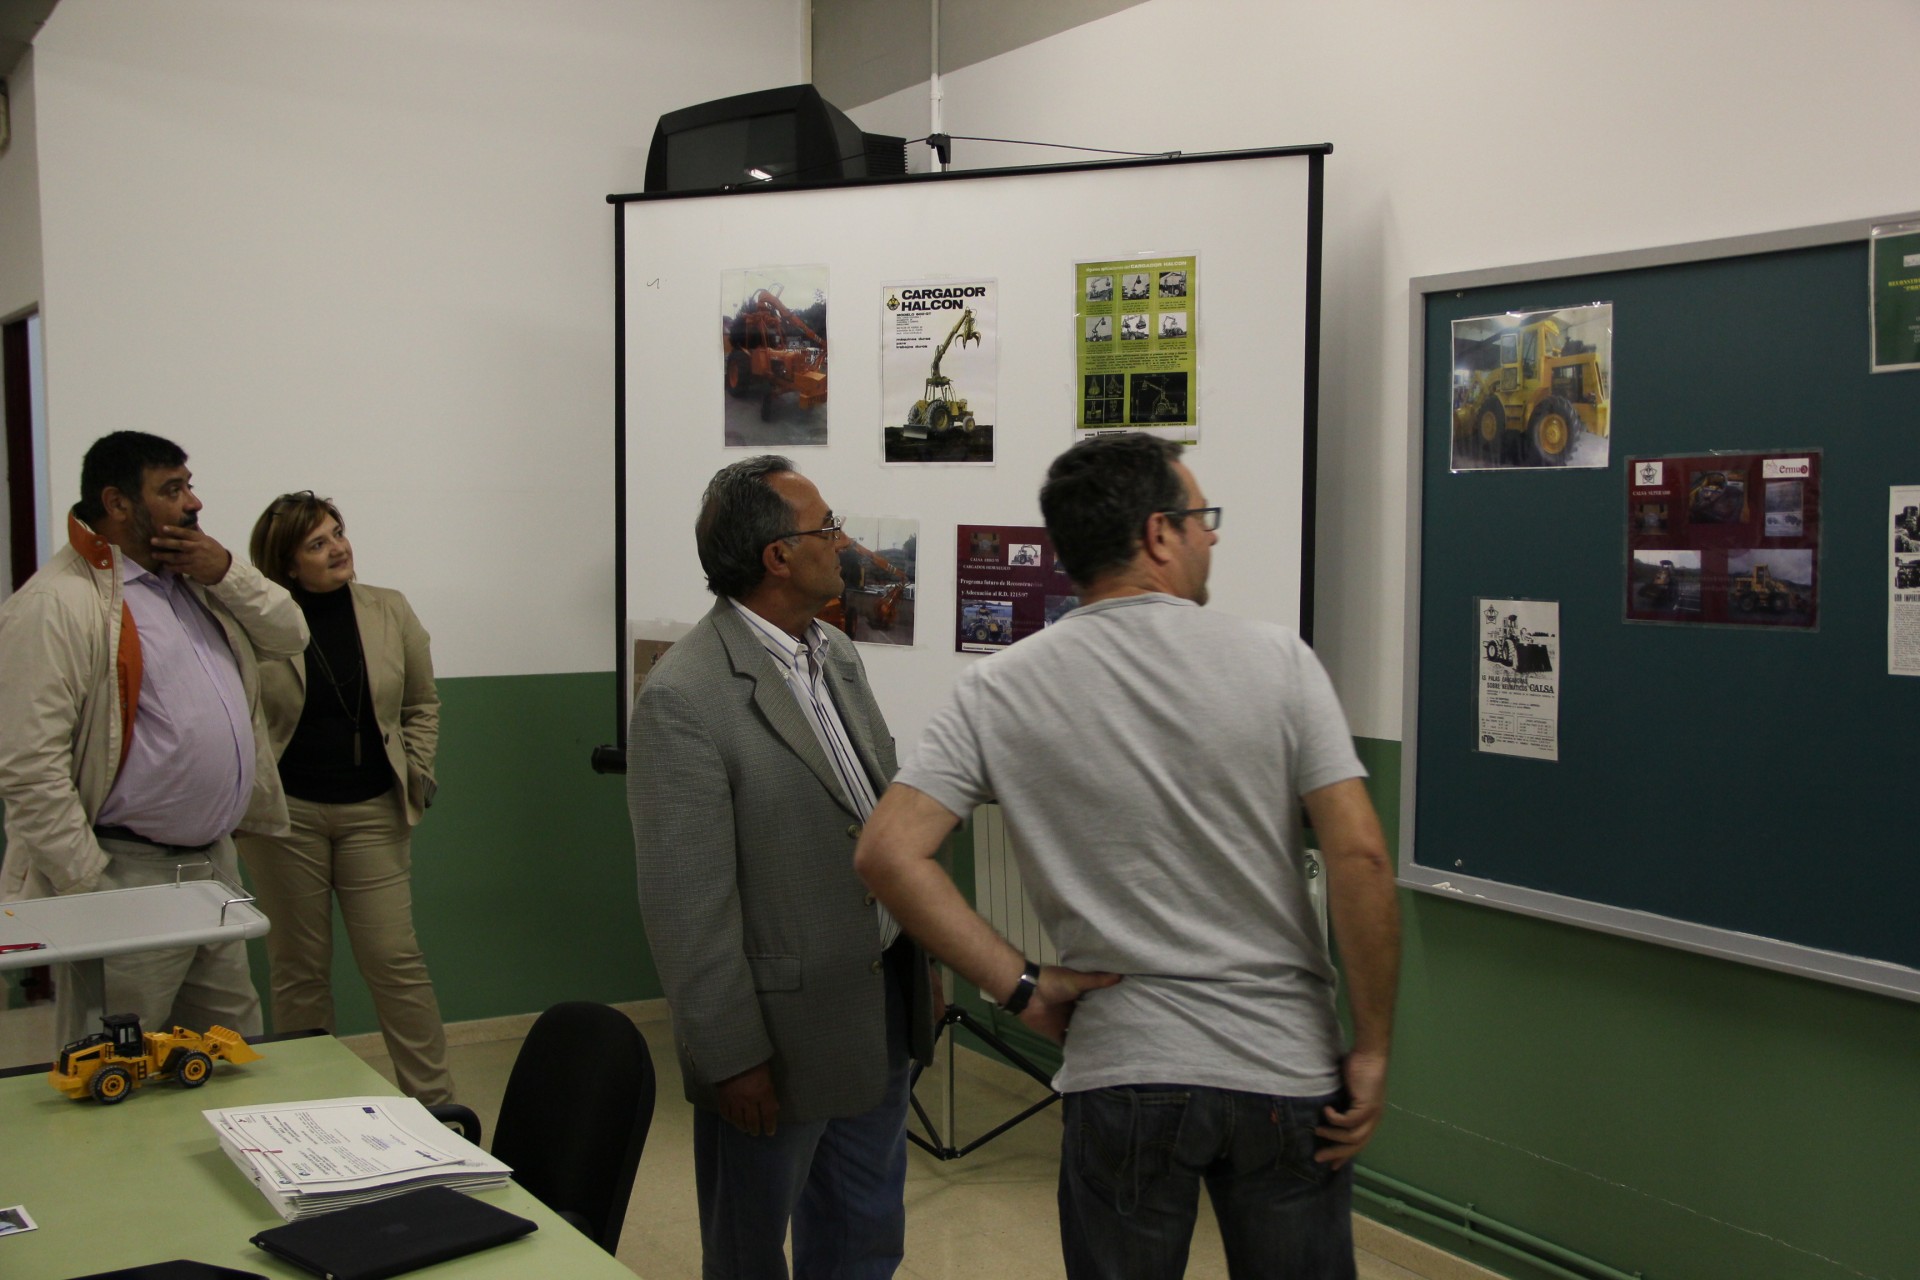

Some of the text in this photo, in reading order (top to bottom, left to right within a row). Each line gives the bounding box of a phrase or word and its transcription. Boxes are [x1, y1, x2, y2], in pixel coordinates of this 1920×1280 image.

[902, 287, 986, 299] CARGADOR
[902, 300, 963, 311] HALCON
[1529, 683, 1554, 693] CALSA
